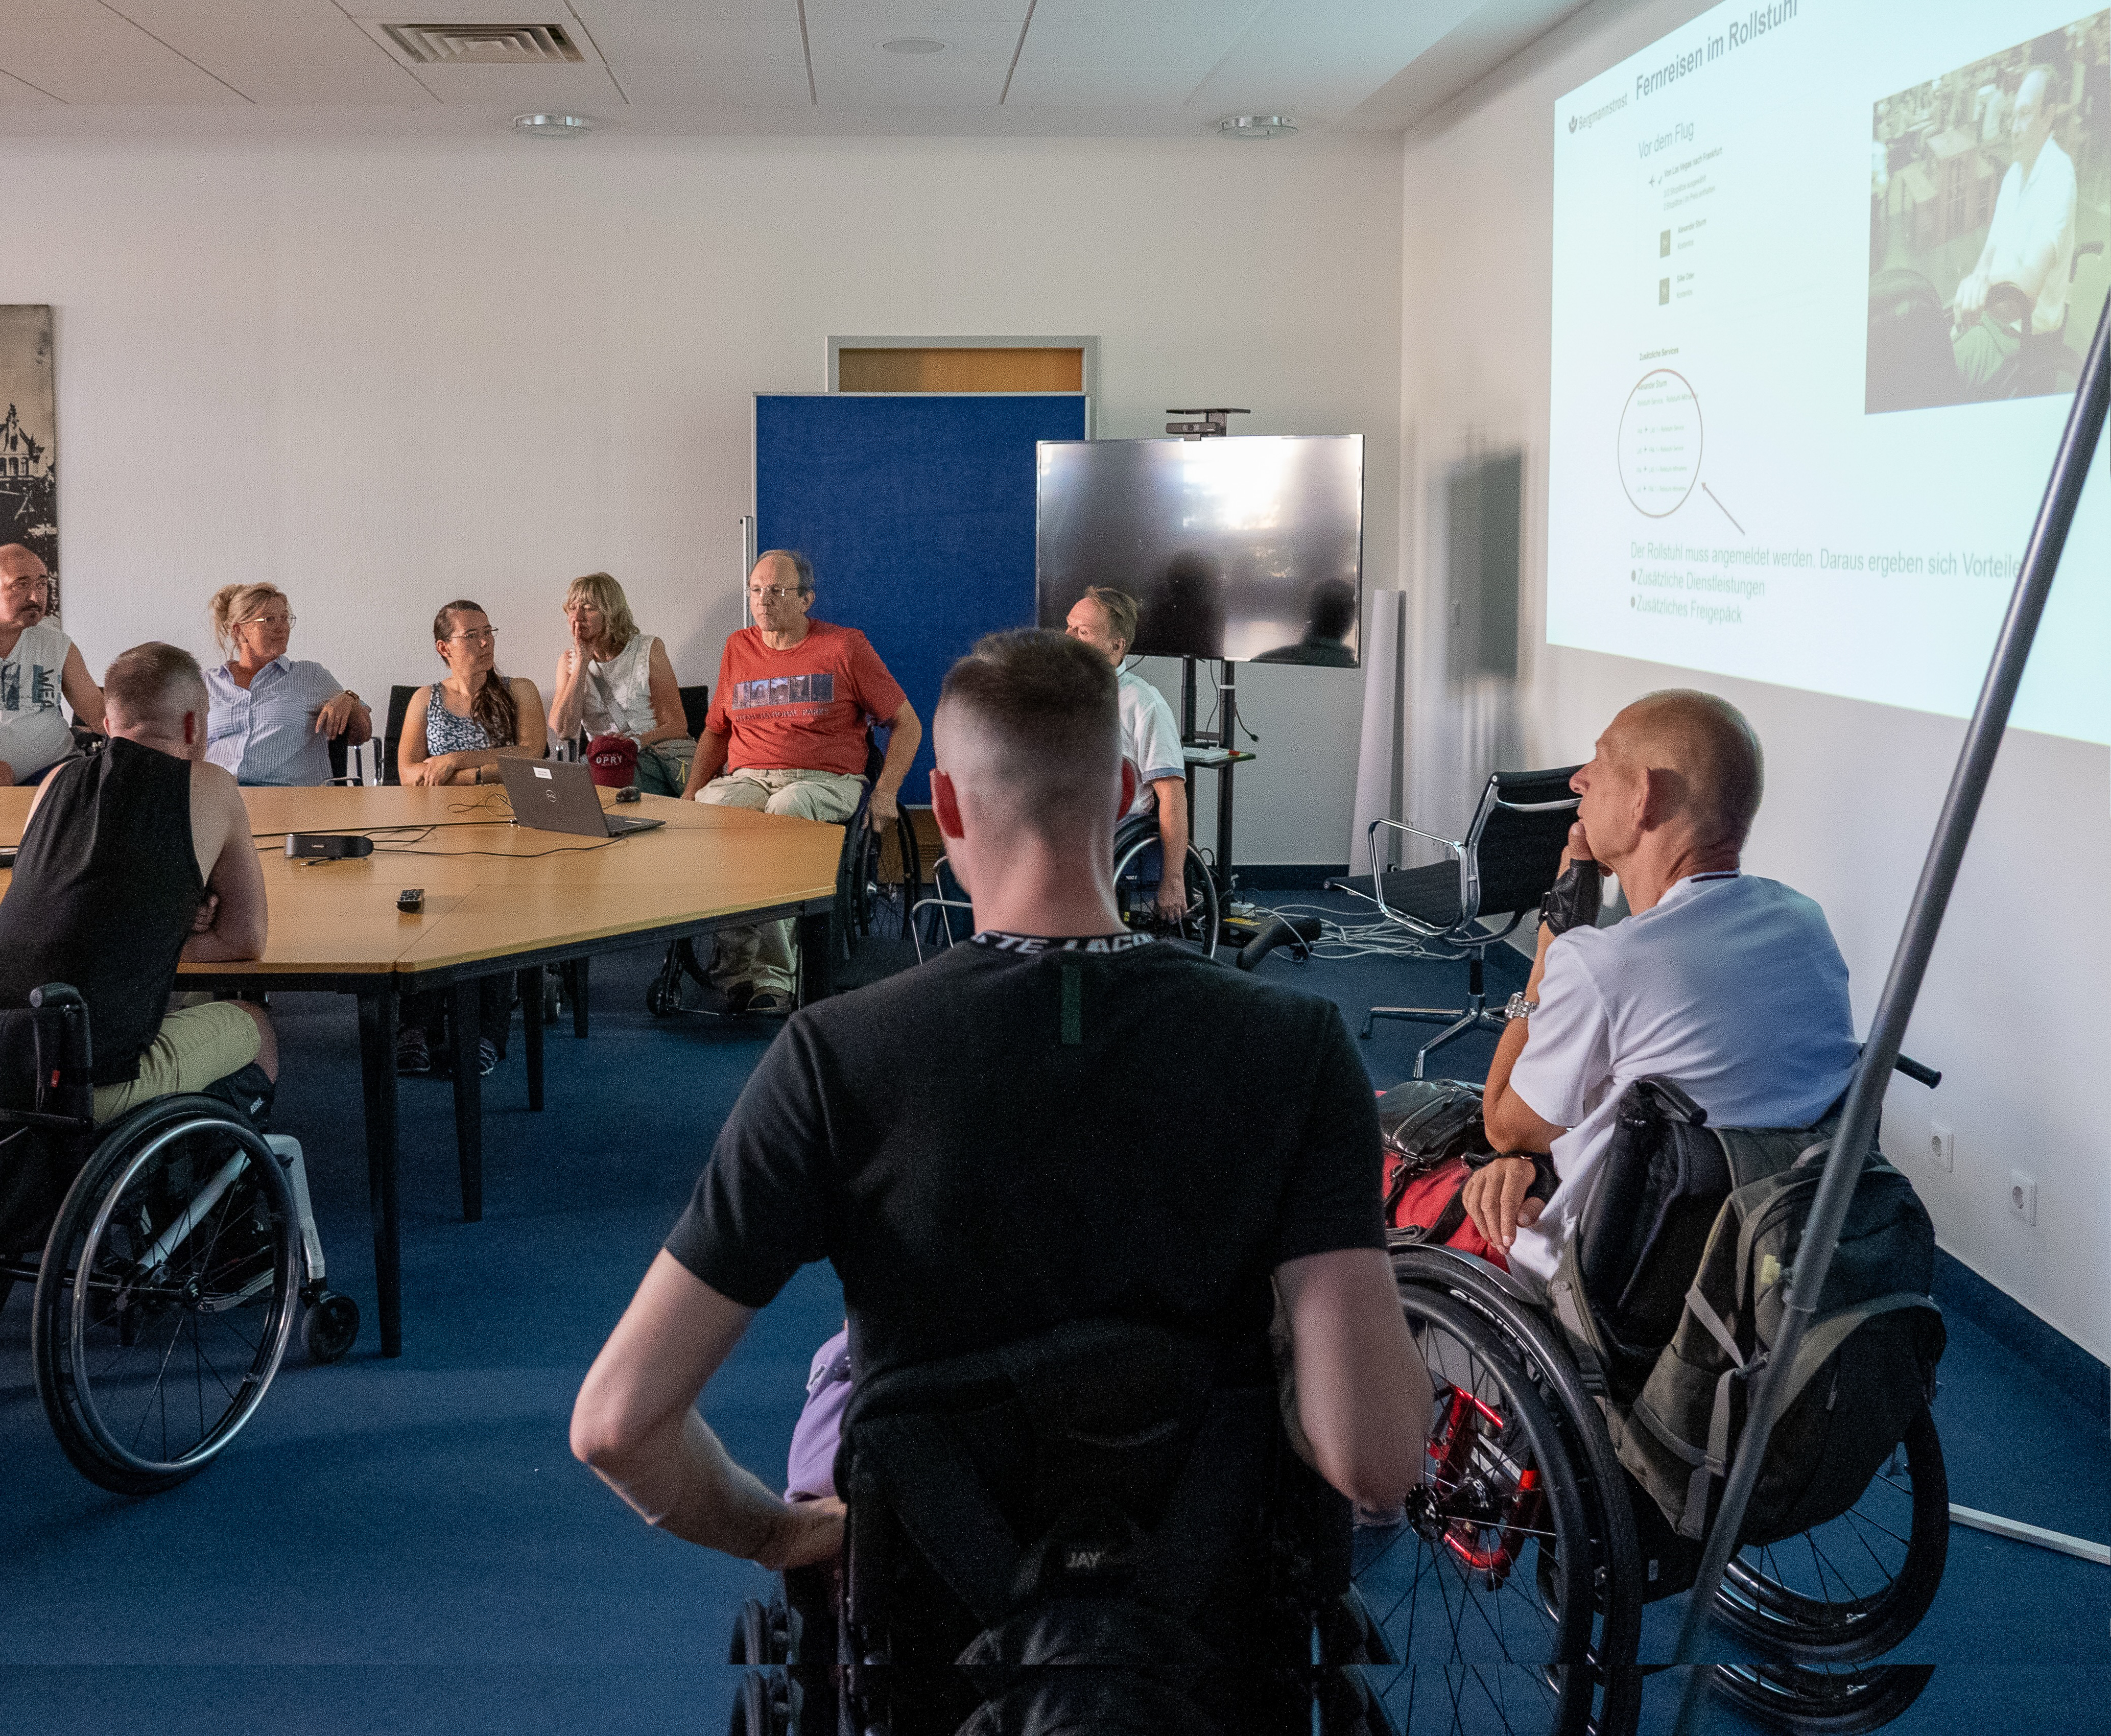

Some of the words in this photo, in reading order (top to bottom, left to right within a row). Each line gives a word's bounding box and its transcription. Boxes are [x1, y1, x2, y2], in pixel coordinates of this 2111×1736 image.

[1636, 47, 1702, 100] Fernreisen
[1707, 36, 1723, 62] im
[1579, 92, 1627, 130] Bergmannstrost
[1638, 141, 1652, 159] Vor
[1654, 132, 1672, 152] dem
[1675, 122, 1694, 141] Flug
[1631, 542, 1645, 559] Der
[1647, 542, 1682, 561] Rollstuhl
[1685, 549, 1709, 563] muss
[1712, 546, 1770, 568] angemeldet
[1773, 548, 1816, 568] werden.
[1820, 549, 1864, 571] Daraus
[1868, 551, 1924, 578] ergeben
[1928, 552, 1957, 576] sich
[1637, 568, 1684, 589] Zusätzliche
[1686, 572, 1765, 600] Dienstleistungen
[1636, 594, 1688, 618] Zusätzliches
[1690, 600, 1743, 625] Freigepäck
[596, 755, 622, 764] OPRY
[1065, 1552, 1101, 1568] JAY
